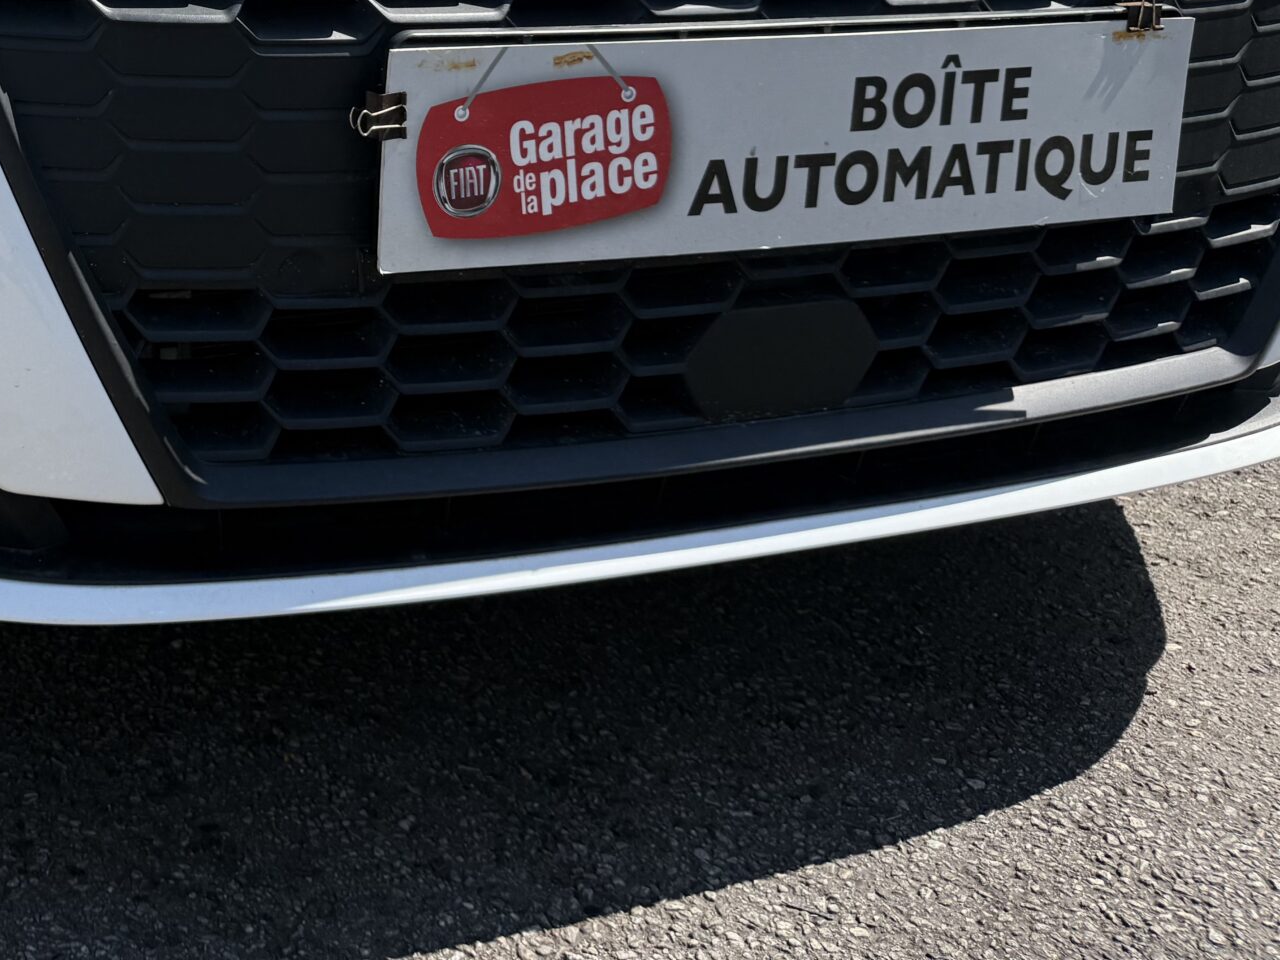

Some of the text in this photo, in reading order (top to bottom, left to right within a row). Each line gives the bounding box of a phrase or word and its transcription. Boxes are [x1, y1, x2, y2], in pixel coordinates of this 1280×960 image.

[850, 54, 1032, 132] BOÎTE
[509, 103, 655, 167] Garage
[449, 164, 487, 200] FIAT
[513, 168, 537, 193] de
[521, 193, 538, 215] la
[539, 152, 658, 216] place
[687, 129, 1154, 216] AUTOMATIQUE
